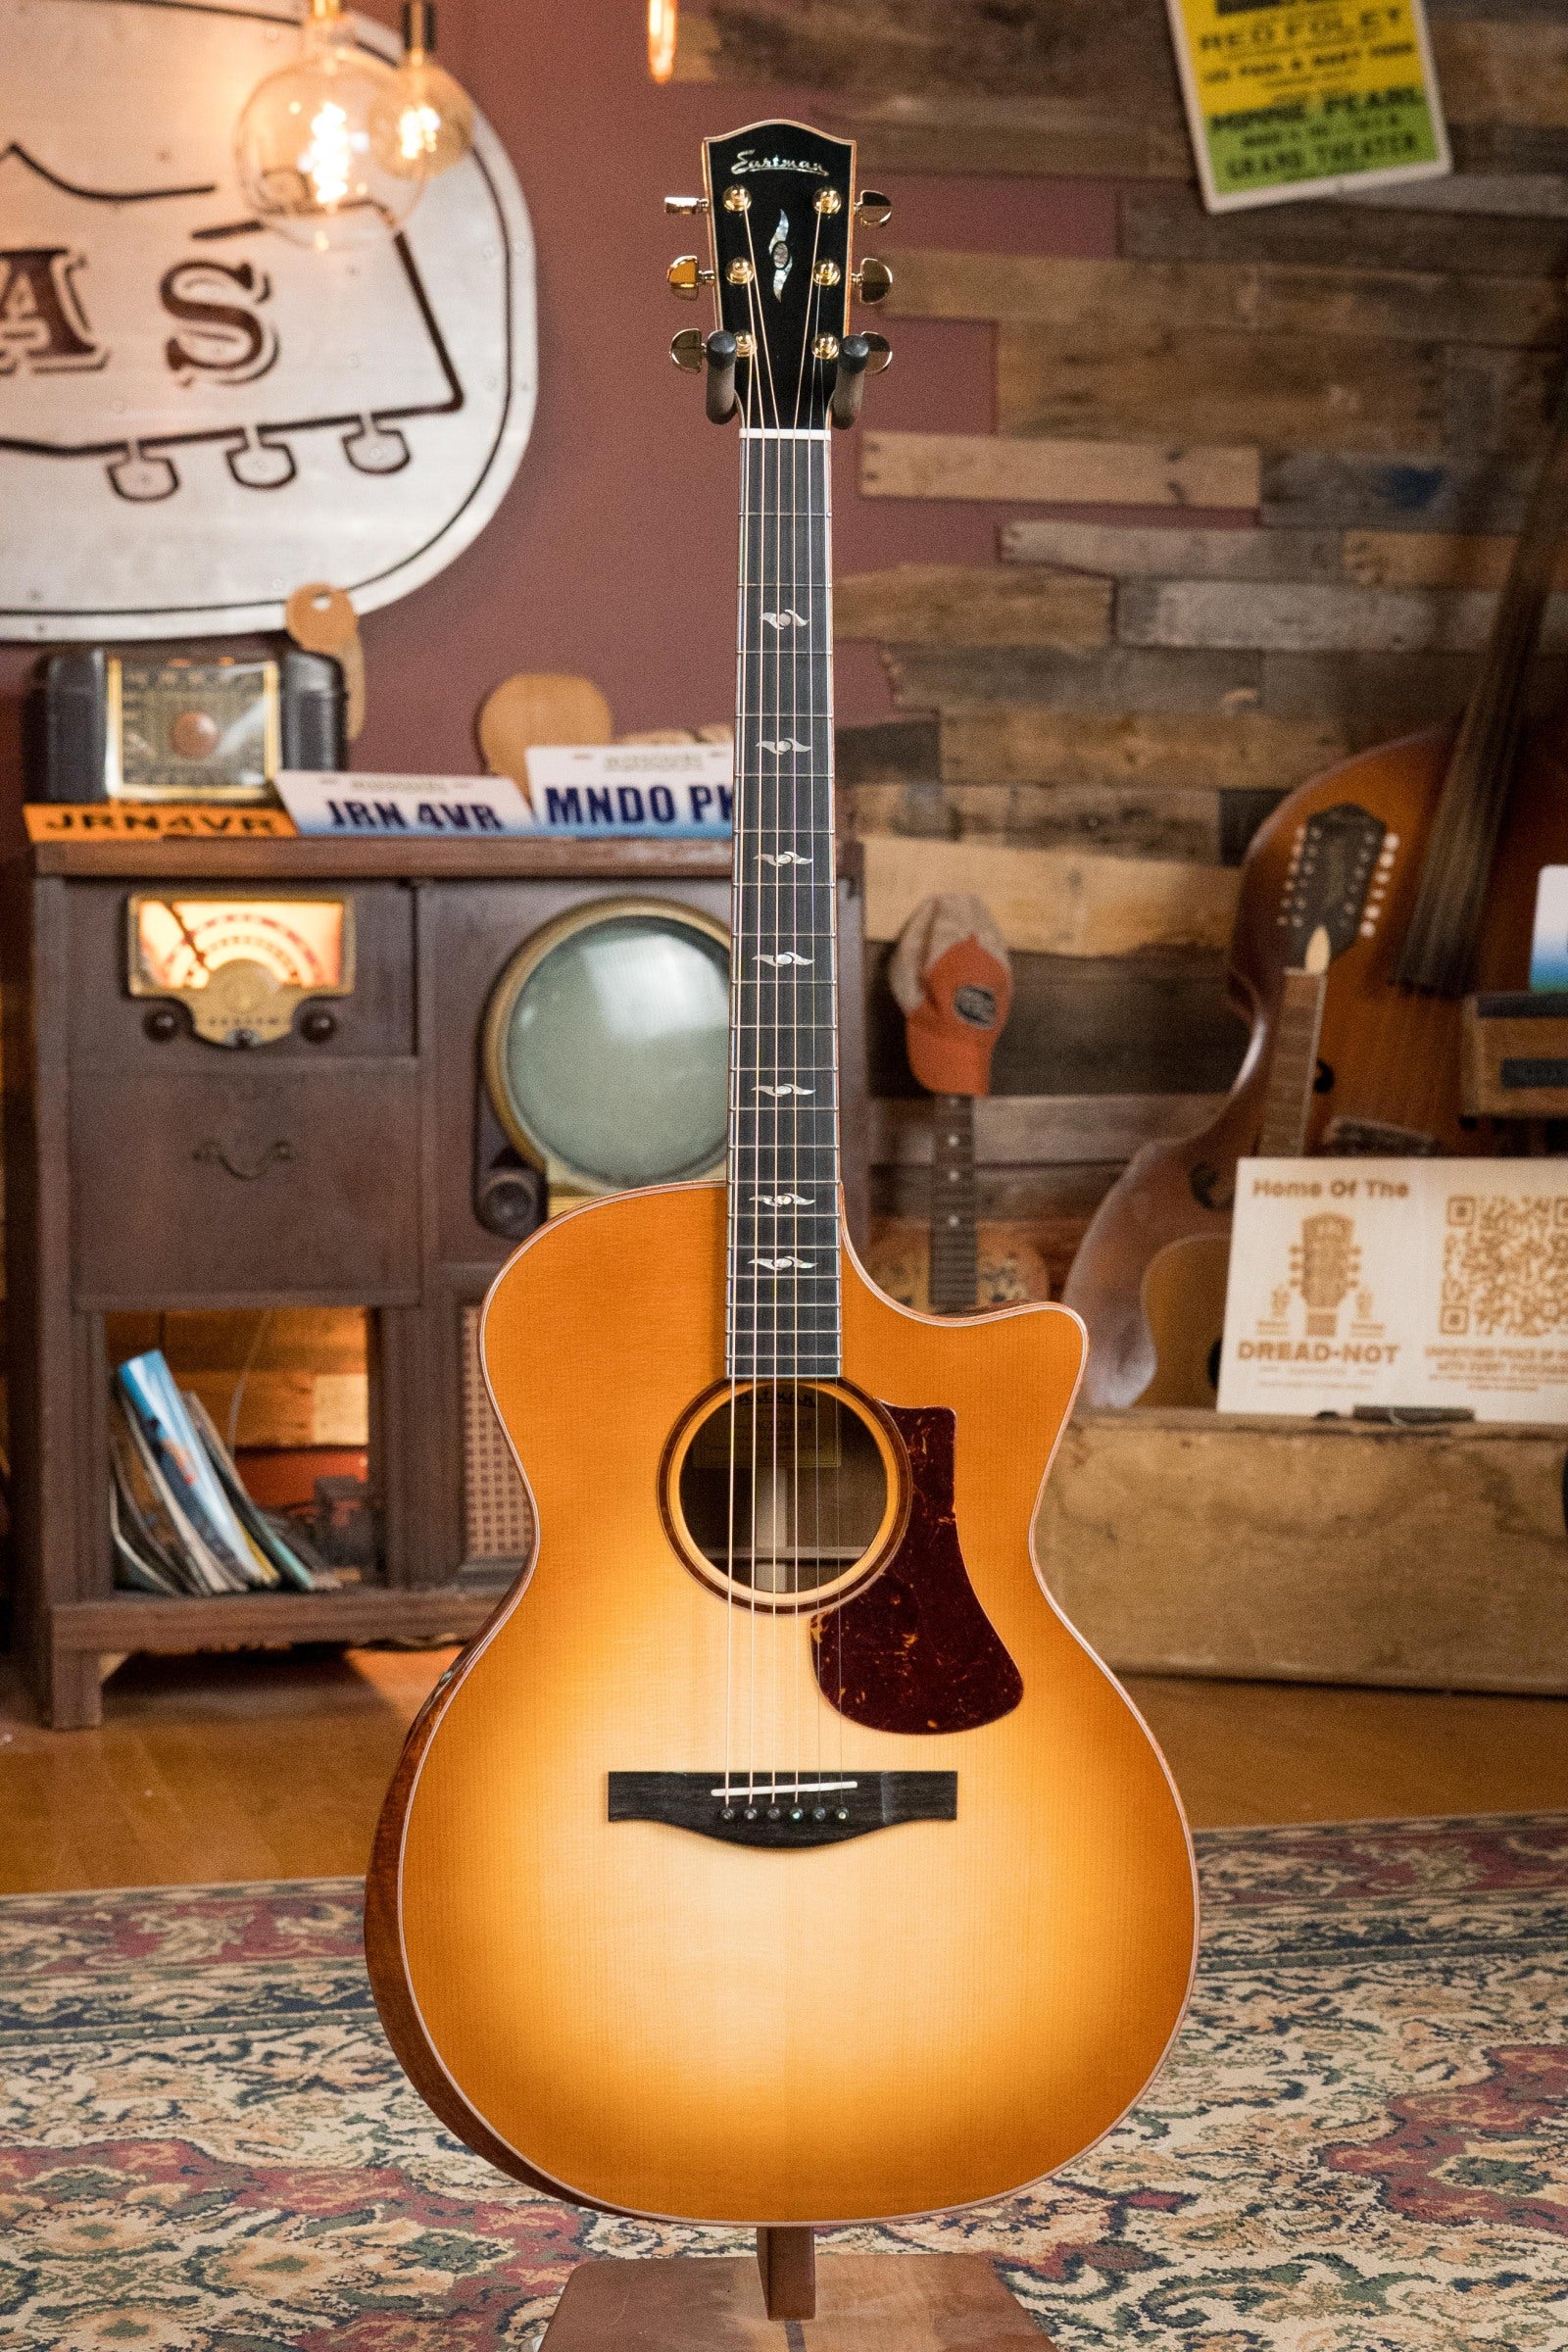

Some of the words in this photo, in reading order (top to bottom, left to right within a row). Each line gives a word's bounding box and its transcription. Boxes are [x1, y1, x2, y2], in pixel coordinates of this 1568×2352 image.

[731, 149, 830, 175] Eastman
[416, 801, 504, 831] 4VR
[544, 785, 676, 824] MNDO
[1252, 1179, 1323, 1198] Home
[1330, 1178, 1357, 1199] Of
[1365, 1179, 1410, 1199] The
[1237, 1342, 1401, 1364] DREAD-NOT
